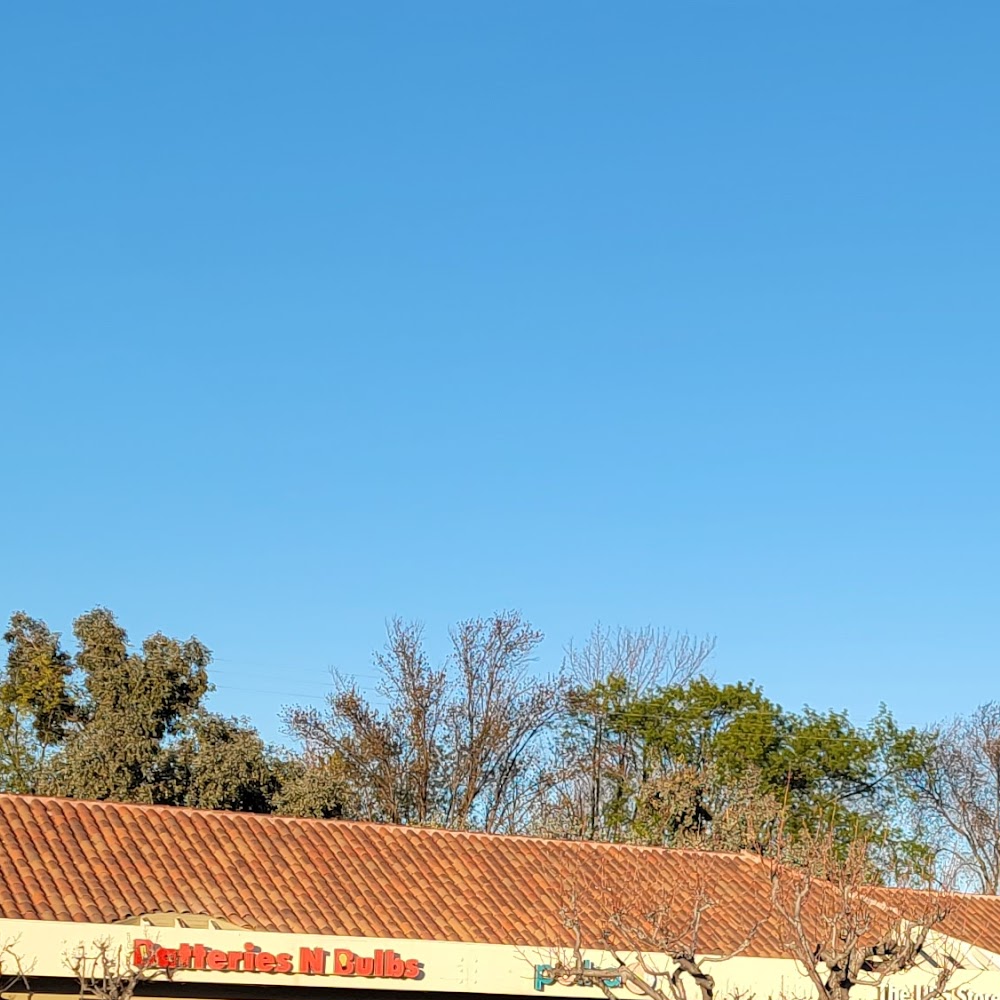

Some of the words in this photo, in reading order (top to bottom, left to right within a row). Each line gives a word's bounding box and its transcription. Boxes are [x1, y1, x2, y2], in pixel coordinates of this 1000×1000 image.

[133, 939, 293, 974] Batteries
[300, 947, 324, 975] N
[334, 949, 421, 979] Bulbs
